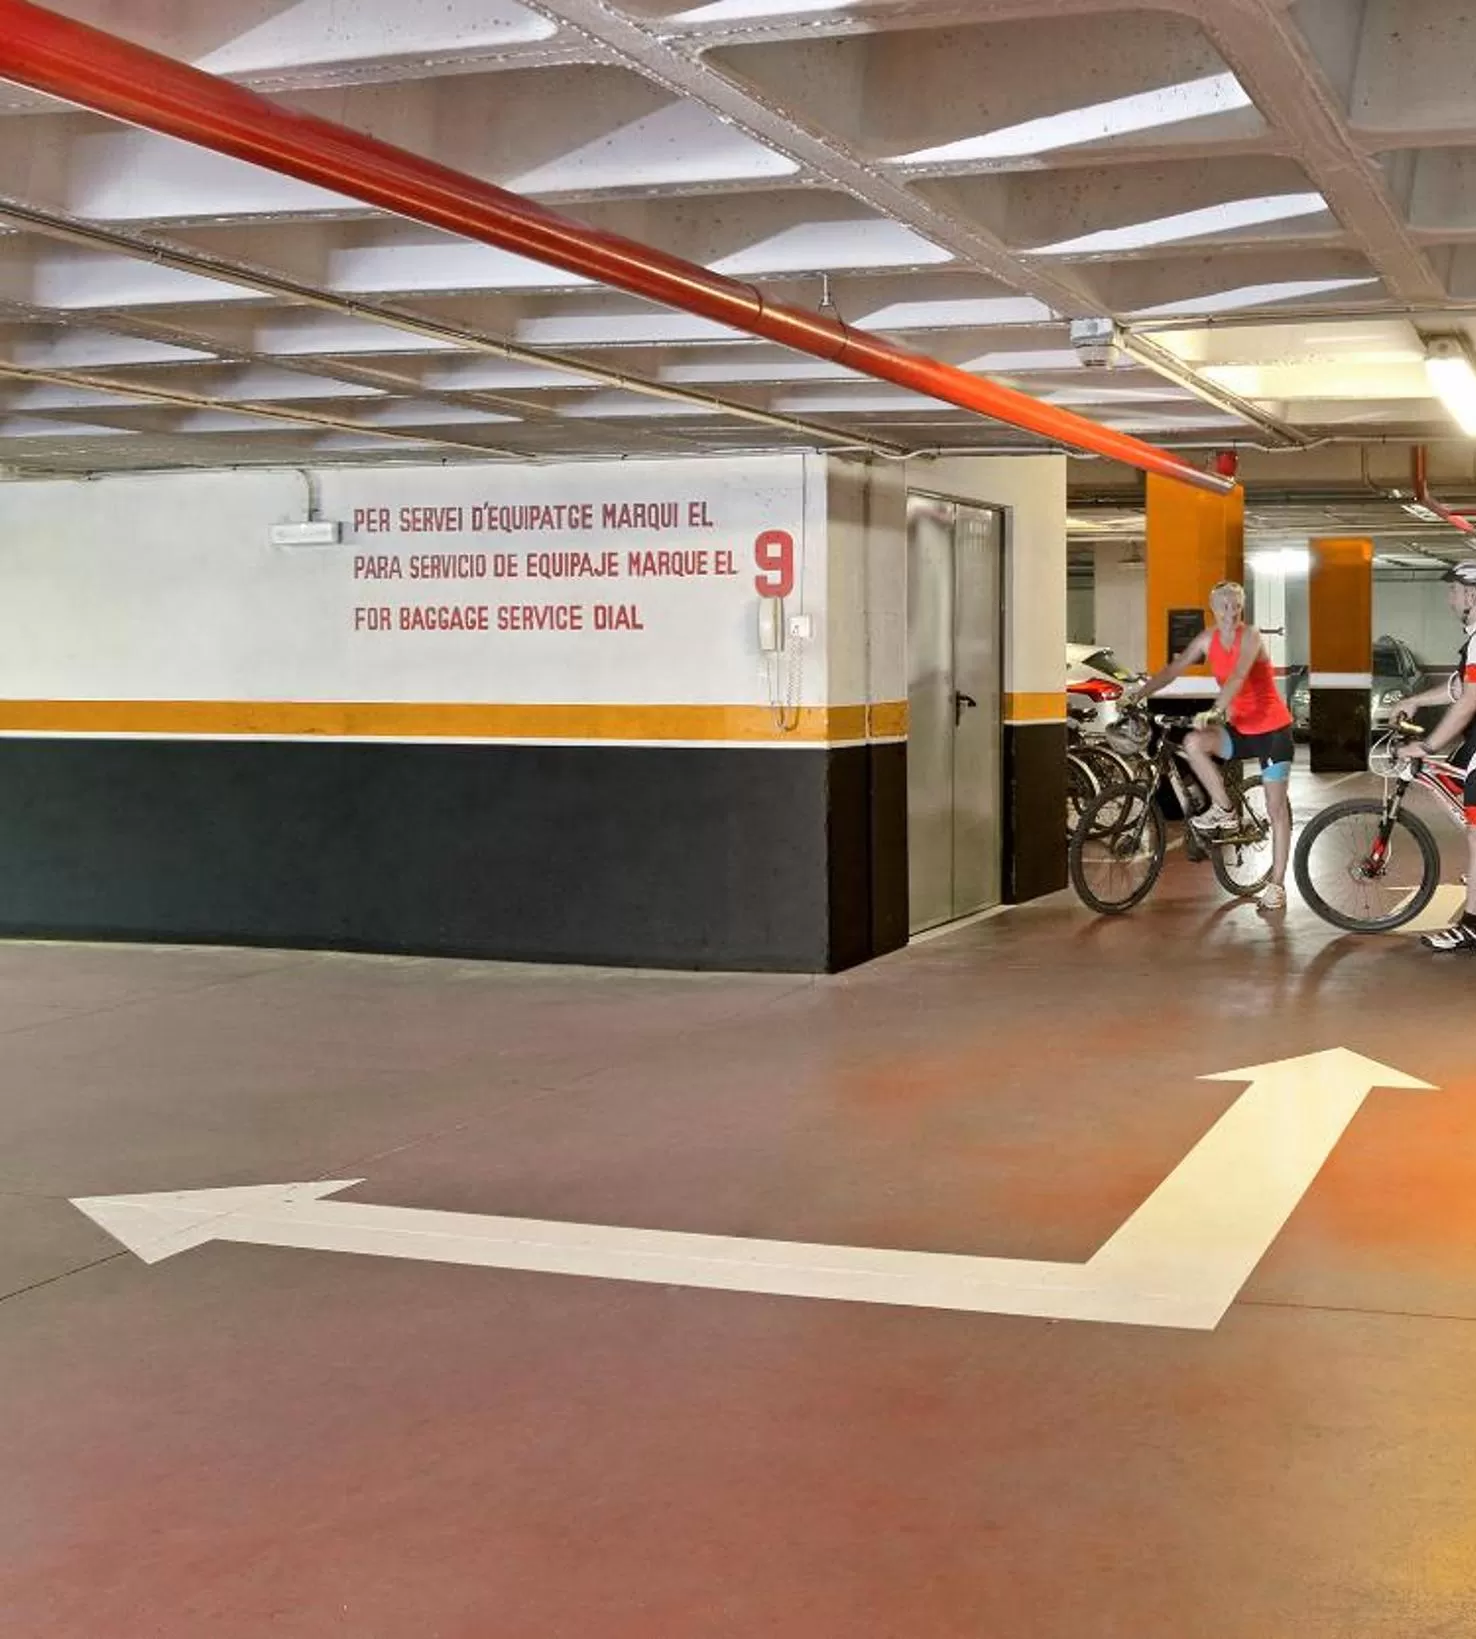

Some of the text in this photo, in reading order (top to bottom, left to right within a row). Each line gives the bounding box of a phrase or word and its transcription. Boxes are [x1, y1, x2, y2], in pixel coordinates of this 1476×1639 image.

[353, 501, 713, 532] PER SERVEI D'EQUIPATGE MARQUI EL
[354, 549, 737, 579] PARA SERVICIO DE EQUIPAJE MARQUE EL
[755, 529, 794, 599] 9
[355, 604, 644, 631] FOR BAGGAGE SERVICE DIAL
